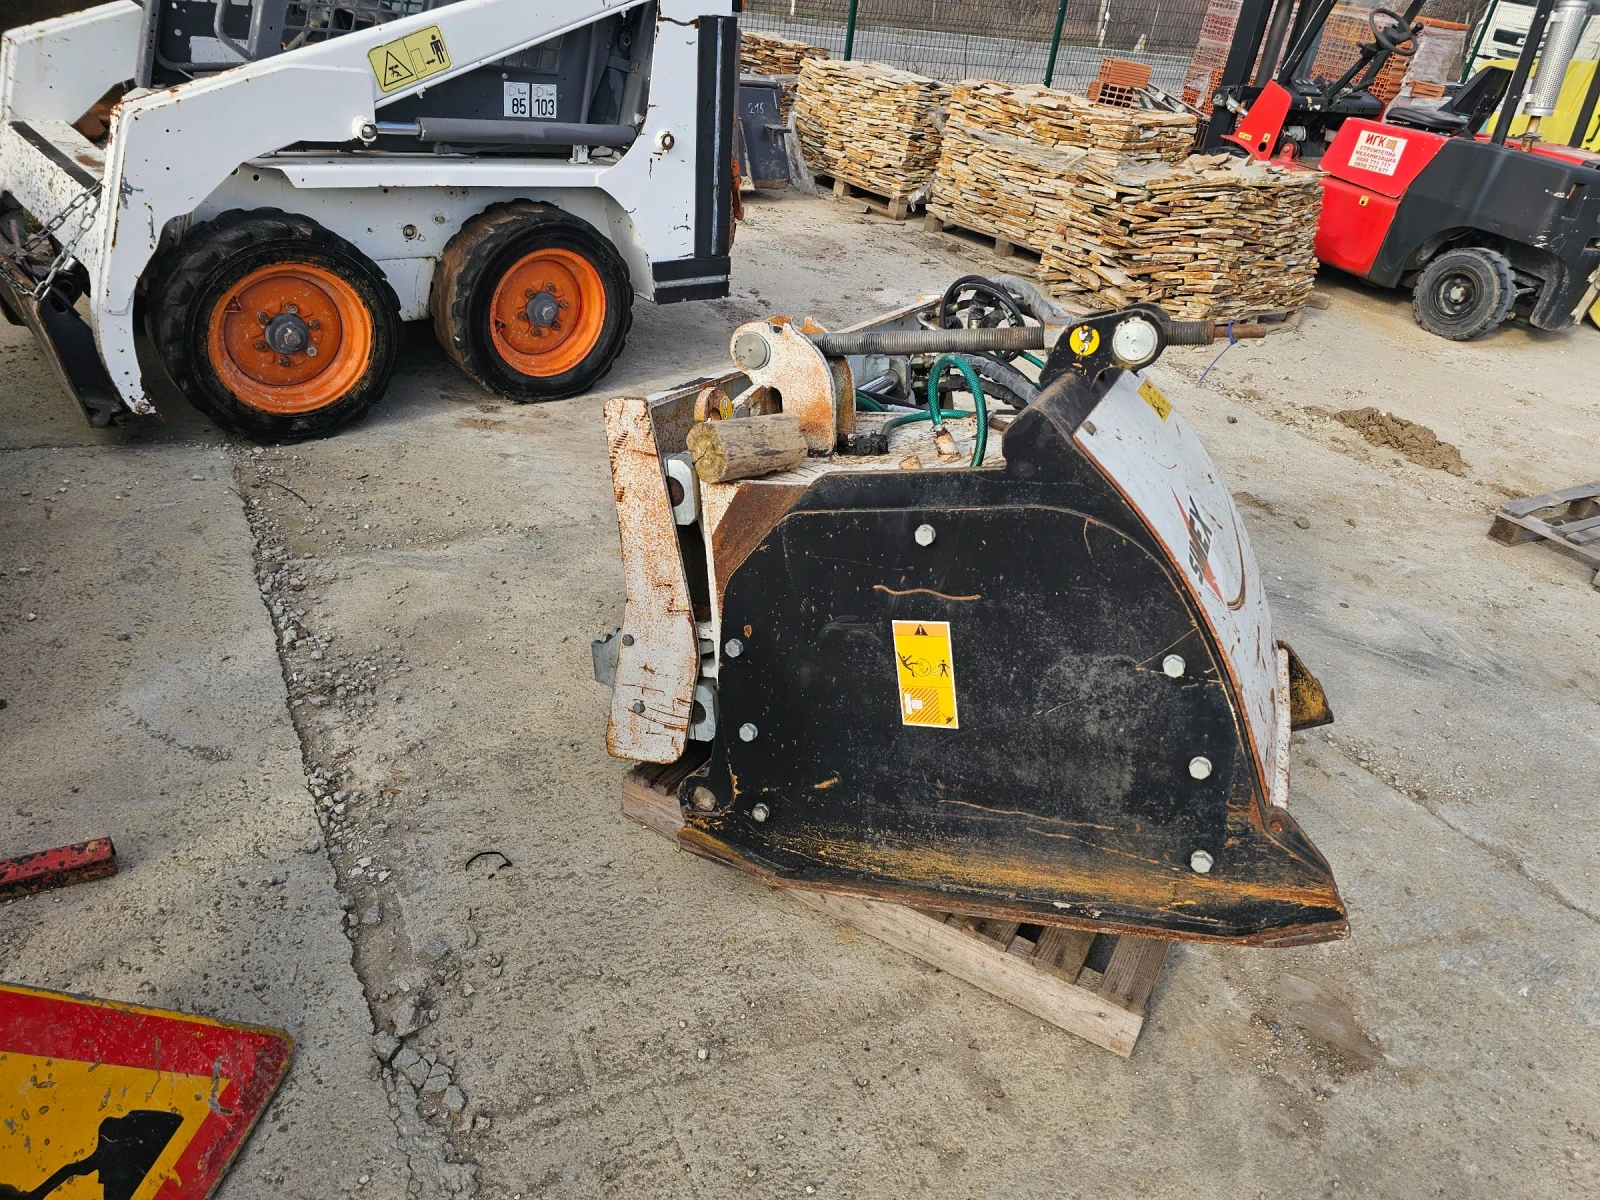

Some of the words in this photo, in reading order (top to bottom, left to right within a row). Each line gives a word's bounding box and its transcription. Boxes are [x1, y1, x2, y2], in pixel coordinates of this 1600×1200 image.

[512, 97, 527, 115] 85
[534, 98, 555, 116] 103
[747, 102, 765, 114] 215
[1365, 133, 1387, 148] ИГК
[1354, 150, 1397, 164] МЕХАНИЗАЦИЯ
[1359, 145, 1396, 158] СТРОИТЕЛНА
